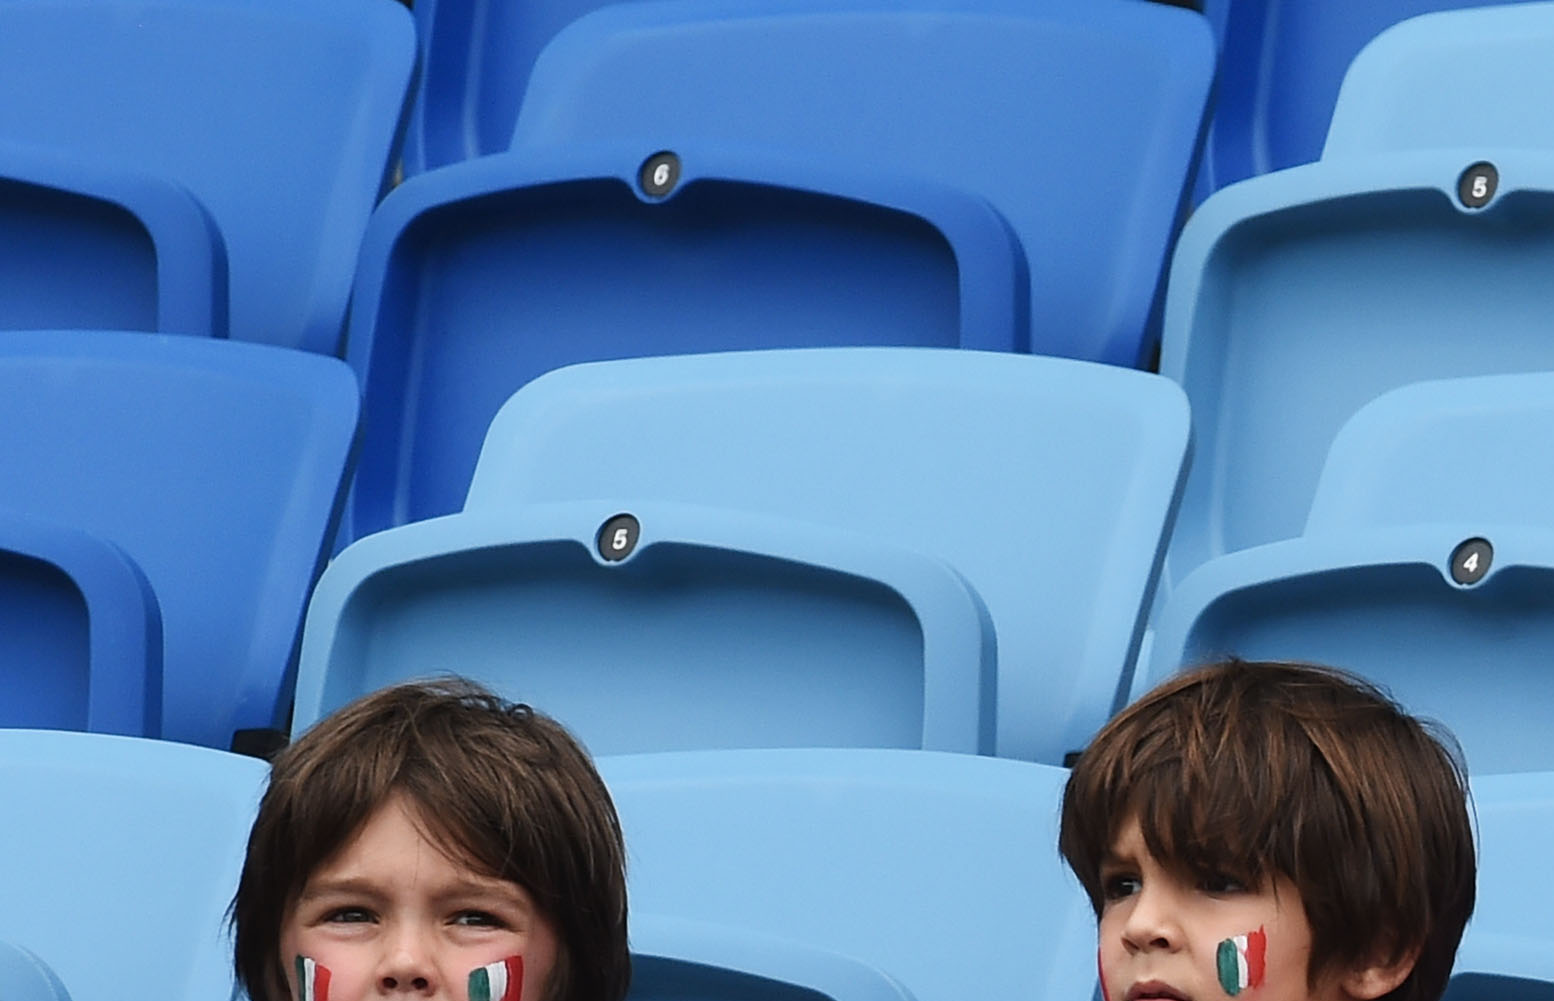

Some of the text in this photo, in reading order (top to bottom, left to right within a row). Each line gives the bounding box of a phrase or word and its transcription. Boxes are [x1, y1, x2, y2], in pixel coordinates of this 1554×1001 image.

[654, 164, 669, 185] 6
[1472, 176, 1487, 197] 5
[612, 529, 628, 550] 5
[1463, 552, 1479, 572] 4
